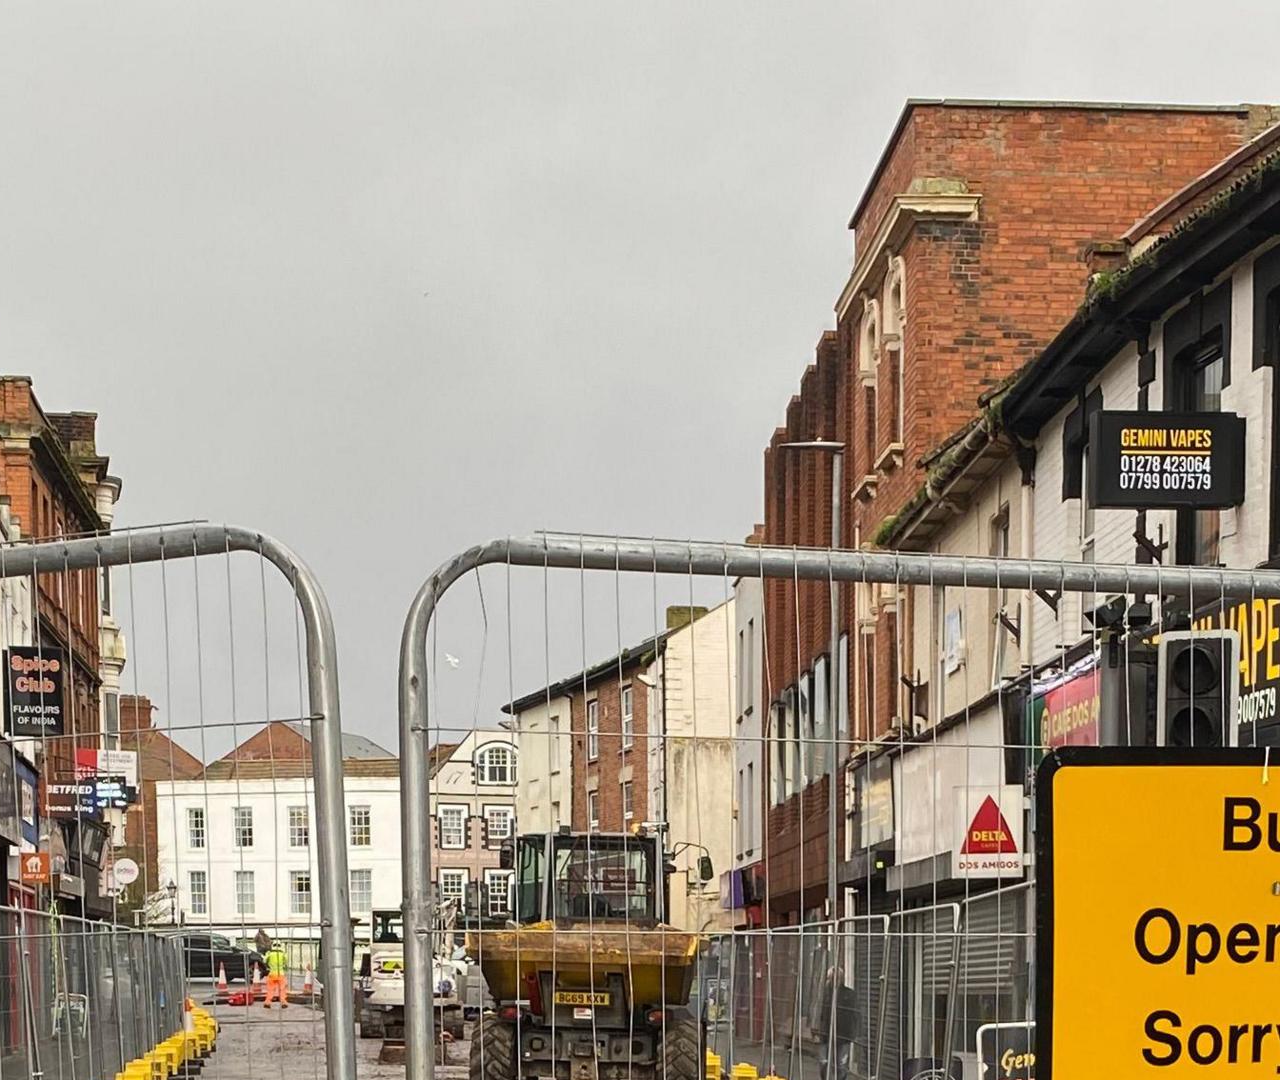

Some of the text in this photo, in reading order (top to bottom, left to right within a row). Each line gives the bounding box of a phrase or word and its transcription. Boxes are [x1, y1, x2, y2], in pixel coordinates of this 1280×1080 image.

[1121, 428, 1212, 448] GEMINI VAPES
[1121, 455, 1211, 472] 01278 423064
[1120, 473, 1211, 490] 07799 007579
[11, 655, 60, 674] Spice
[15, 676, 56, 693] Club
[13, 705, 60, 714] FLAVOURS
[17, 716, 56, 725] OF INDIA
[46, 784, 93, 794] BETFRED
[972, 830, 1008, 842] DELTA
[959, 861, 1019, 870] DOS AMIGOS
